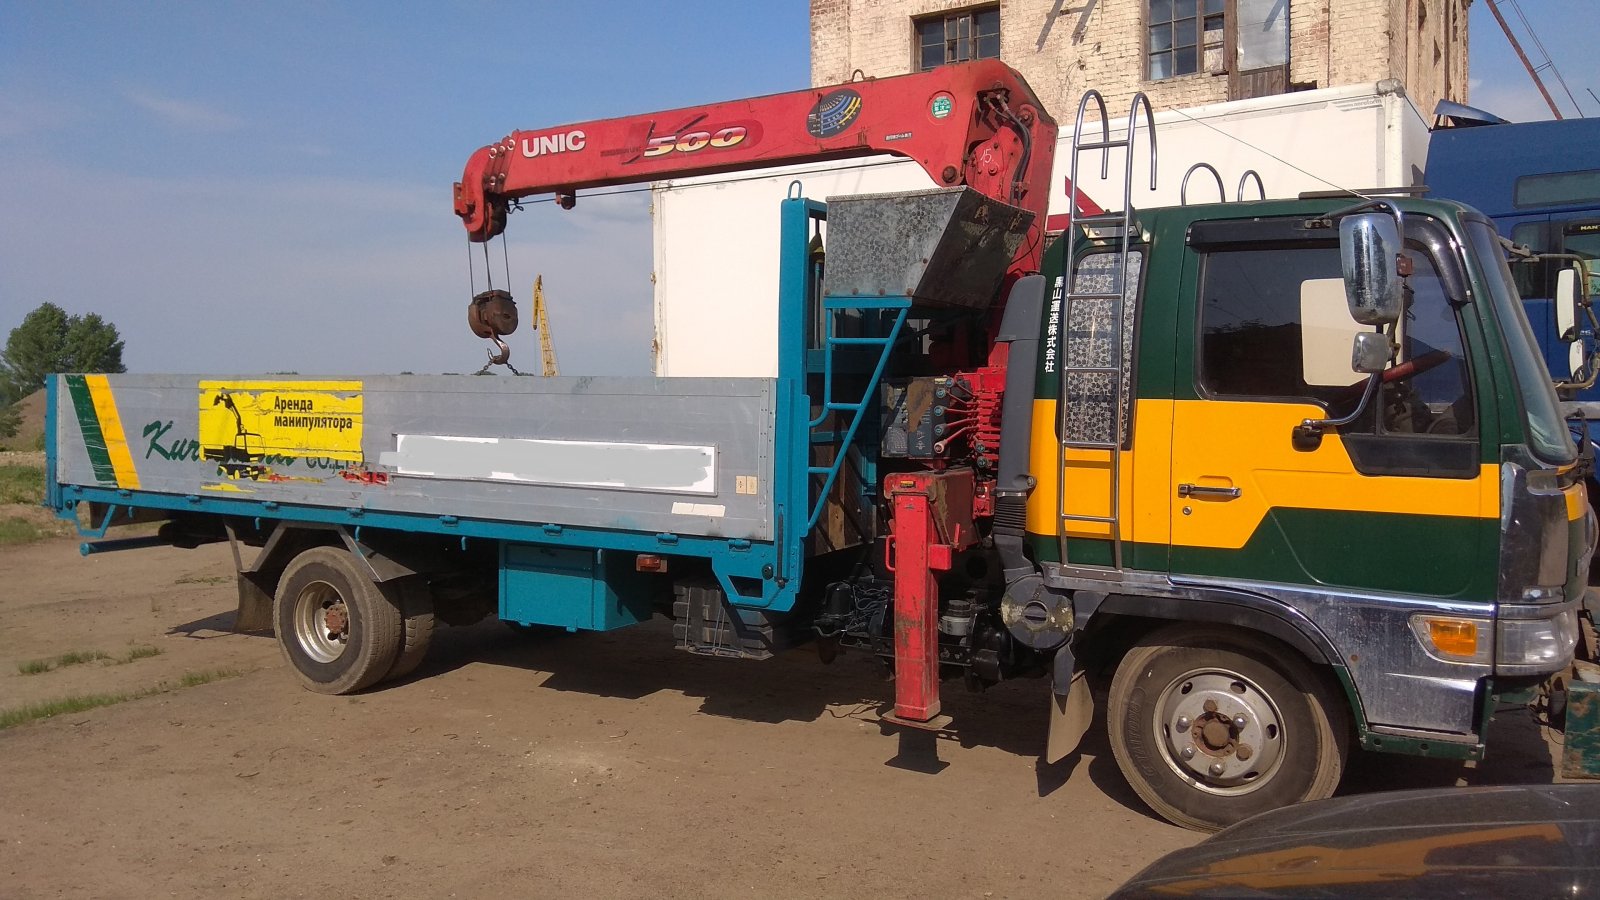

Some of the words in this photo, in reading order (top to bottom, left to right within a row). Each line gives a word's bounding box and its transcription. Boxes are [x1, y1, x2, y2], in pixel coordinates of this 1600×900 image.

[522, 130, 586, 158] UNIC
[644, 127, 748, 157] 500
[274, 396, 313, 413] Аренда
[274, 415, 353, 432] манипулятора
